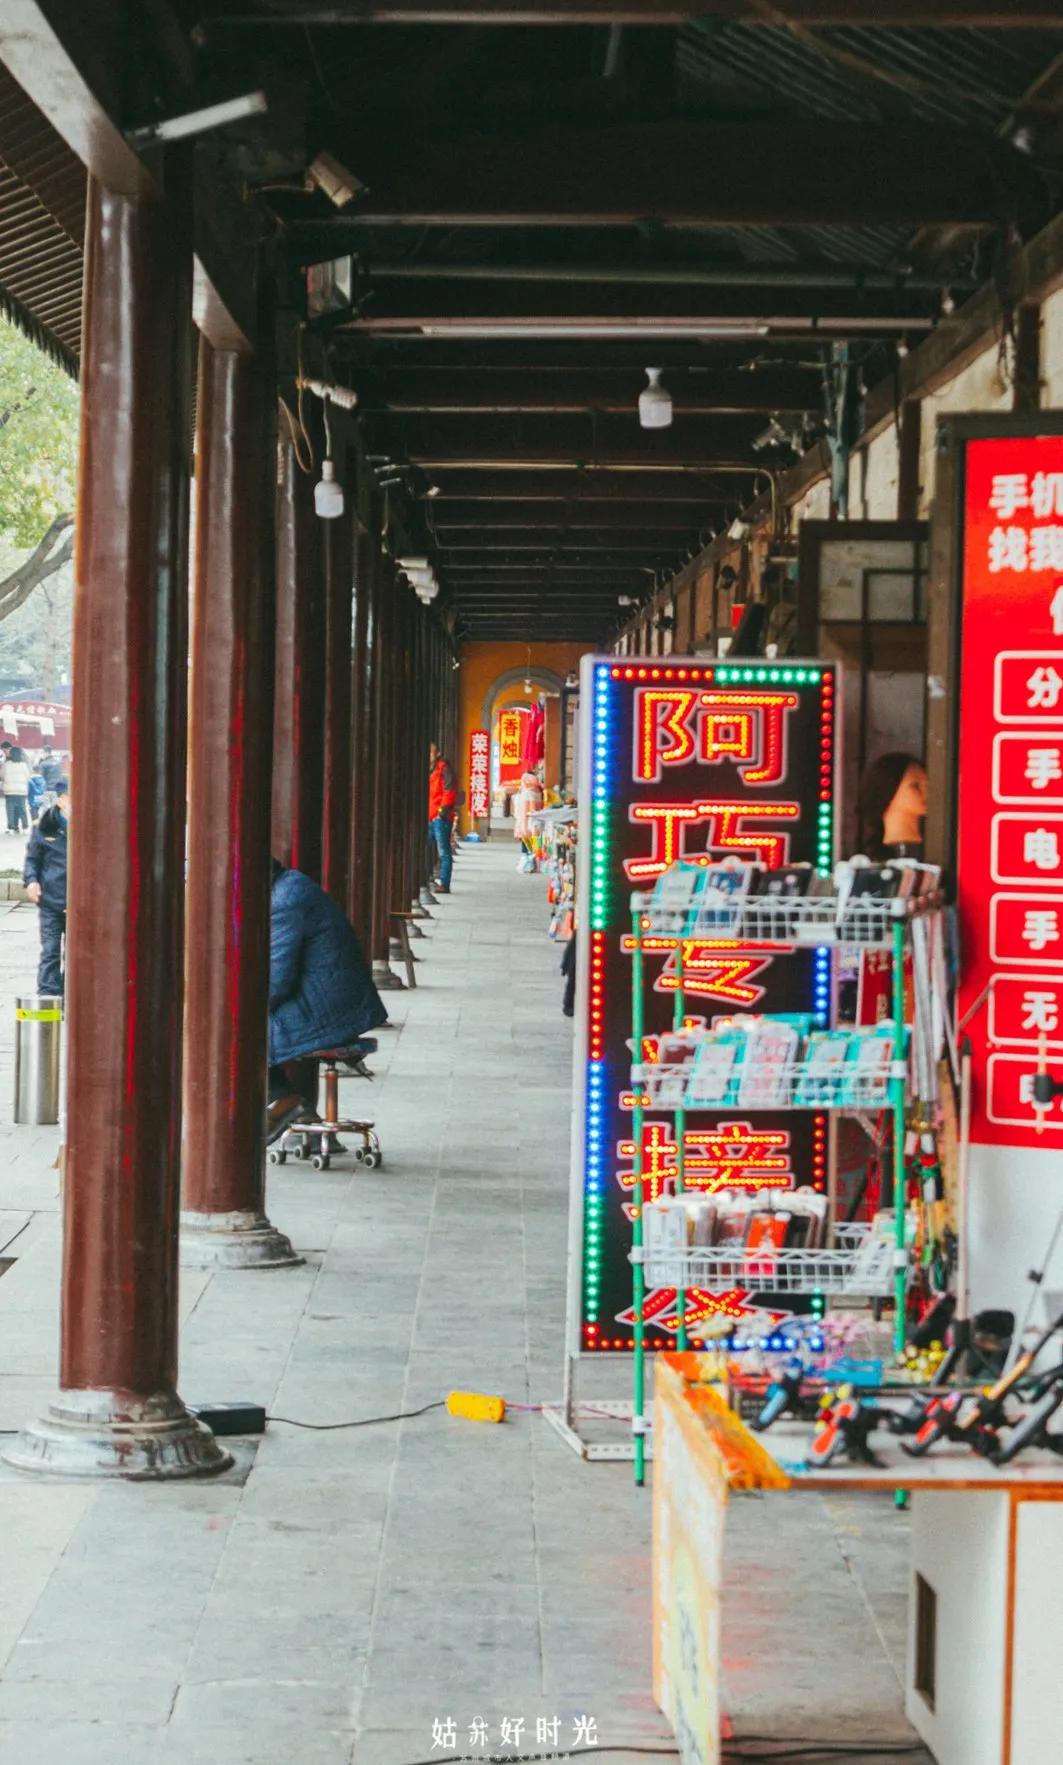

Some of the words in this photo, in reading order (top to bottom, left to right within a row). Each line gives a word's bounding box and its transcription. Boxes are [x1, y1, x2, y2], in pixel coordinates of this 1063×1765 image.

[989, 471, 1063, 518] 手机
[1026, 666, 1063, 708] 分
[1024, 748, 1062, 789] 手
[1023, 828, 1060, 870] 电
[1021, 910, 1060, 950] 手
[614, 687, 799, 1334] 阿巧专接
[1021, 991, 1059, 1032] 无
